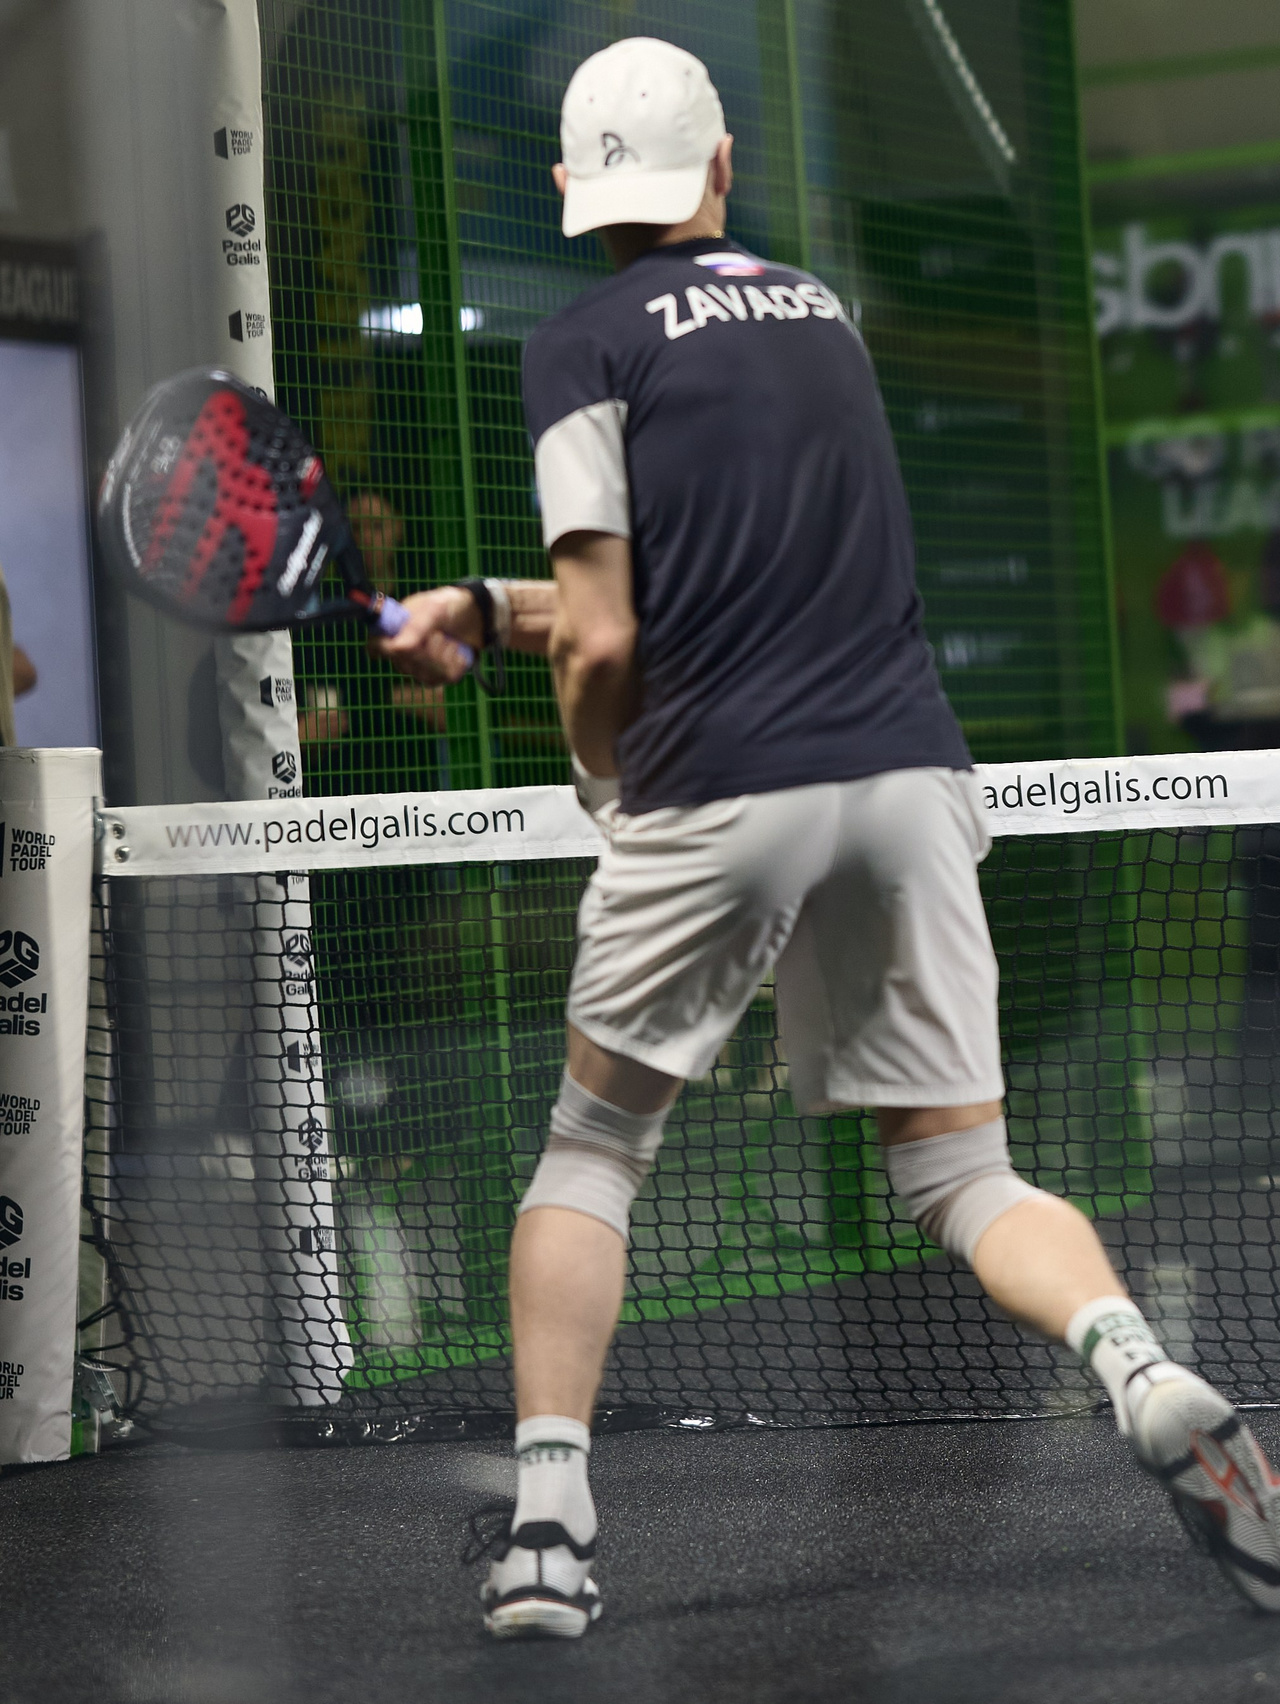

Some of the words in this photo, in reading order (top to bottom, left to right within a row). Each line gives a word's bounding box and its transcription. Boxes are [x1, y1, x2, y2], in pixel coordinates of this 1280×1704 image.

[222, 239, 261, 253] Padel
[227, 253, 260, 266] Galis
[645, 283, 845, 341] ZAVADS
[166, 805, 525, 853] www.padelgalis.com
[12, 828, 56, 846] WORLD
[11, 843, 52, 858] PADEL
[10, 857, 46, 872] TOUR
